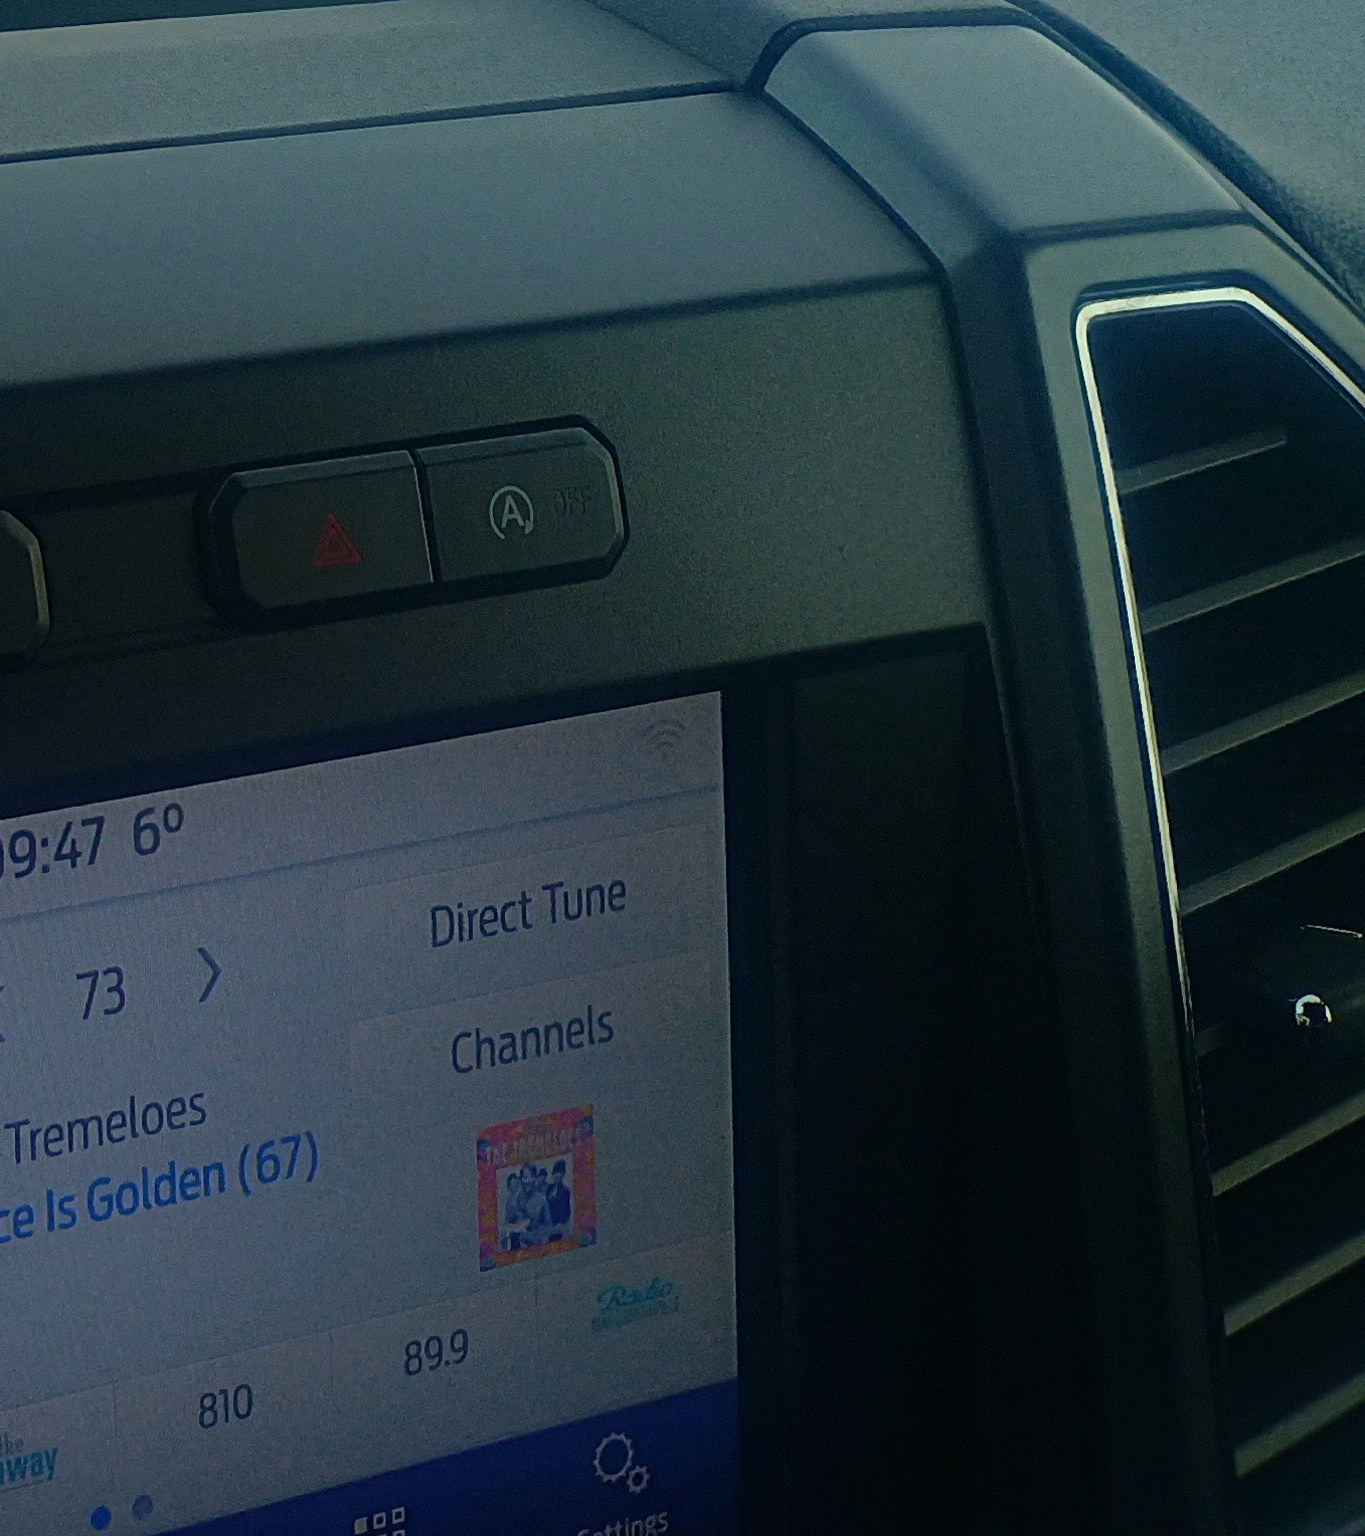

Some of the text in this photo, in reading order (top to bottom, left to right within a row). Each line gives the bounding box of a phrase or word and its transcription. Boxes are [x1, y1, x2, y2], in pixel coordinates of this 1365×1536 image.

[430, 879, 627, 949] Direct Tune
[75, 966, 126, 1021] 73
[451, 1004, 615, 1074] Channels
[3, 1092, 207, 1165] Tremeloes
[45, 1188, 78, 1233] Is
[86, 1160, 227, 1223] Golden
[238, 1130, 319, 1197] (67)
[403, 1328, 469, 1377] 89.9
[198, 1383, 254, 1430] 810
